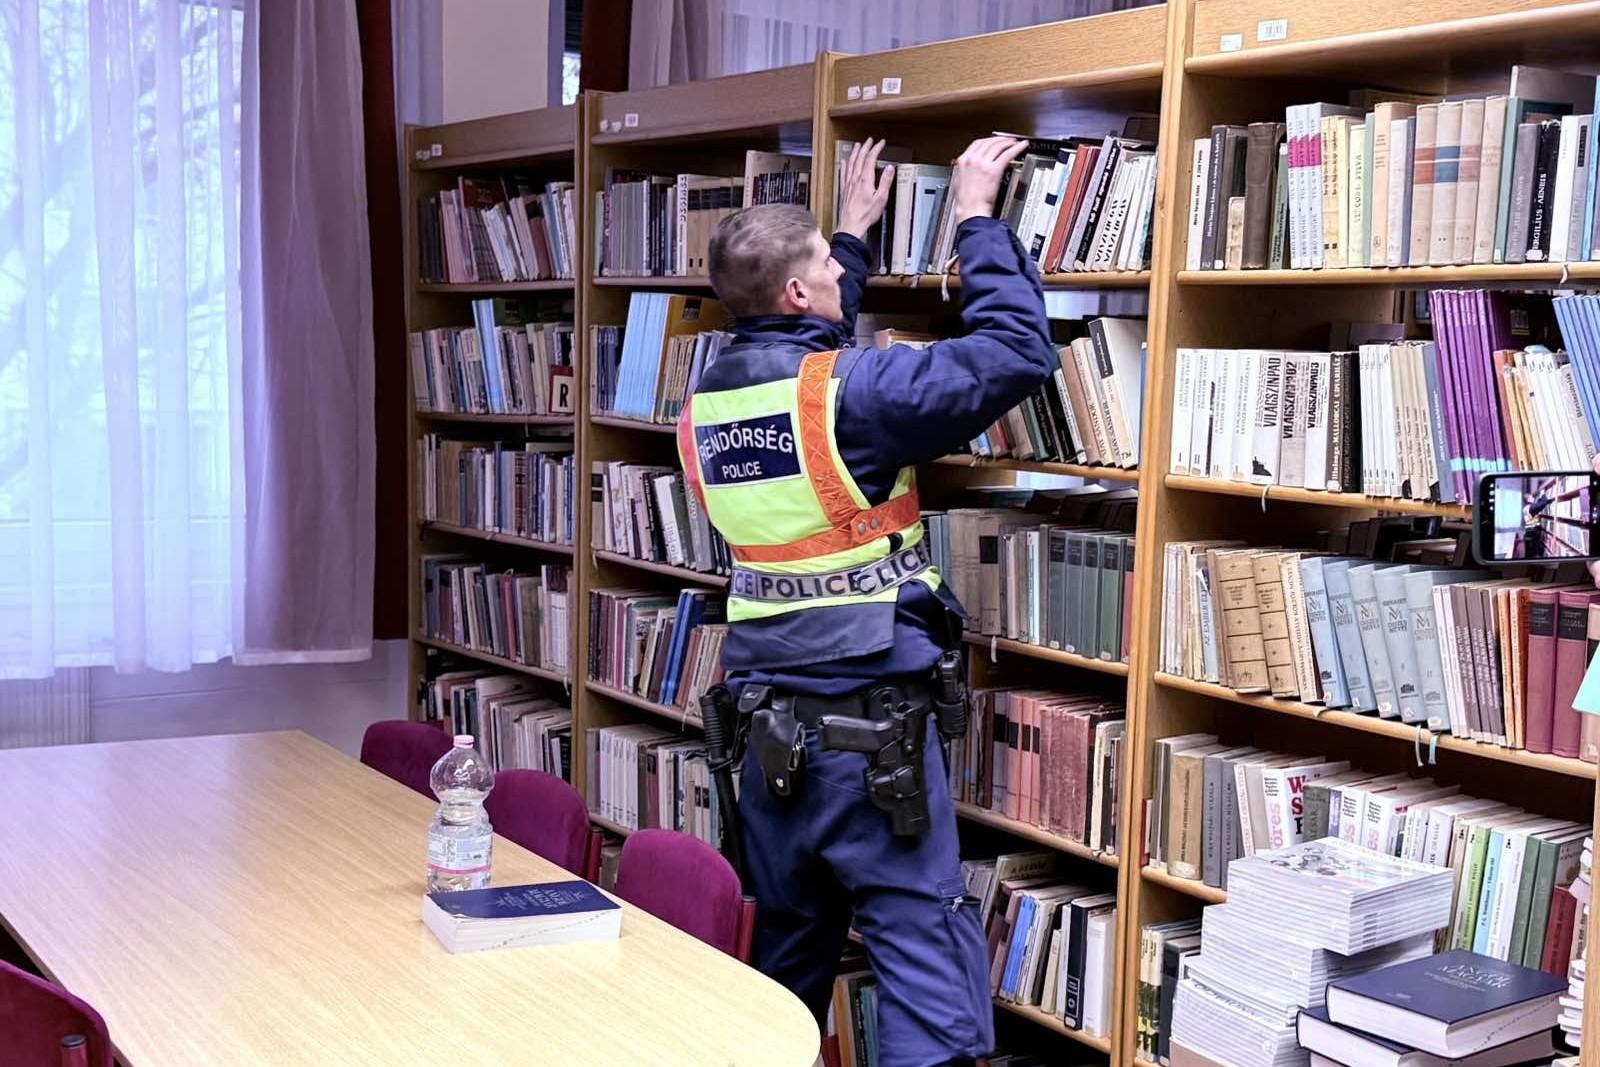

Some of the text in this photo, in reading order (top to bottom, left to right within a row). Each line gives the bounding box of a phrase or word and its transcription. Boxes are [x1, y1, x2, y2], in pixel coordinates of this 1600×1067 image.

[1531, 208, 1542, 250] ERGILIUS
[560, 383, 569, 408] R
[698, 423, 794, 465] RENDŐRSÉG
[722, 461, 763, 479] POLICE
[761, 570, 862, 598] POLICE
